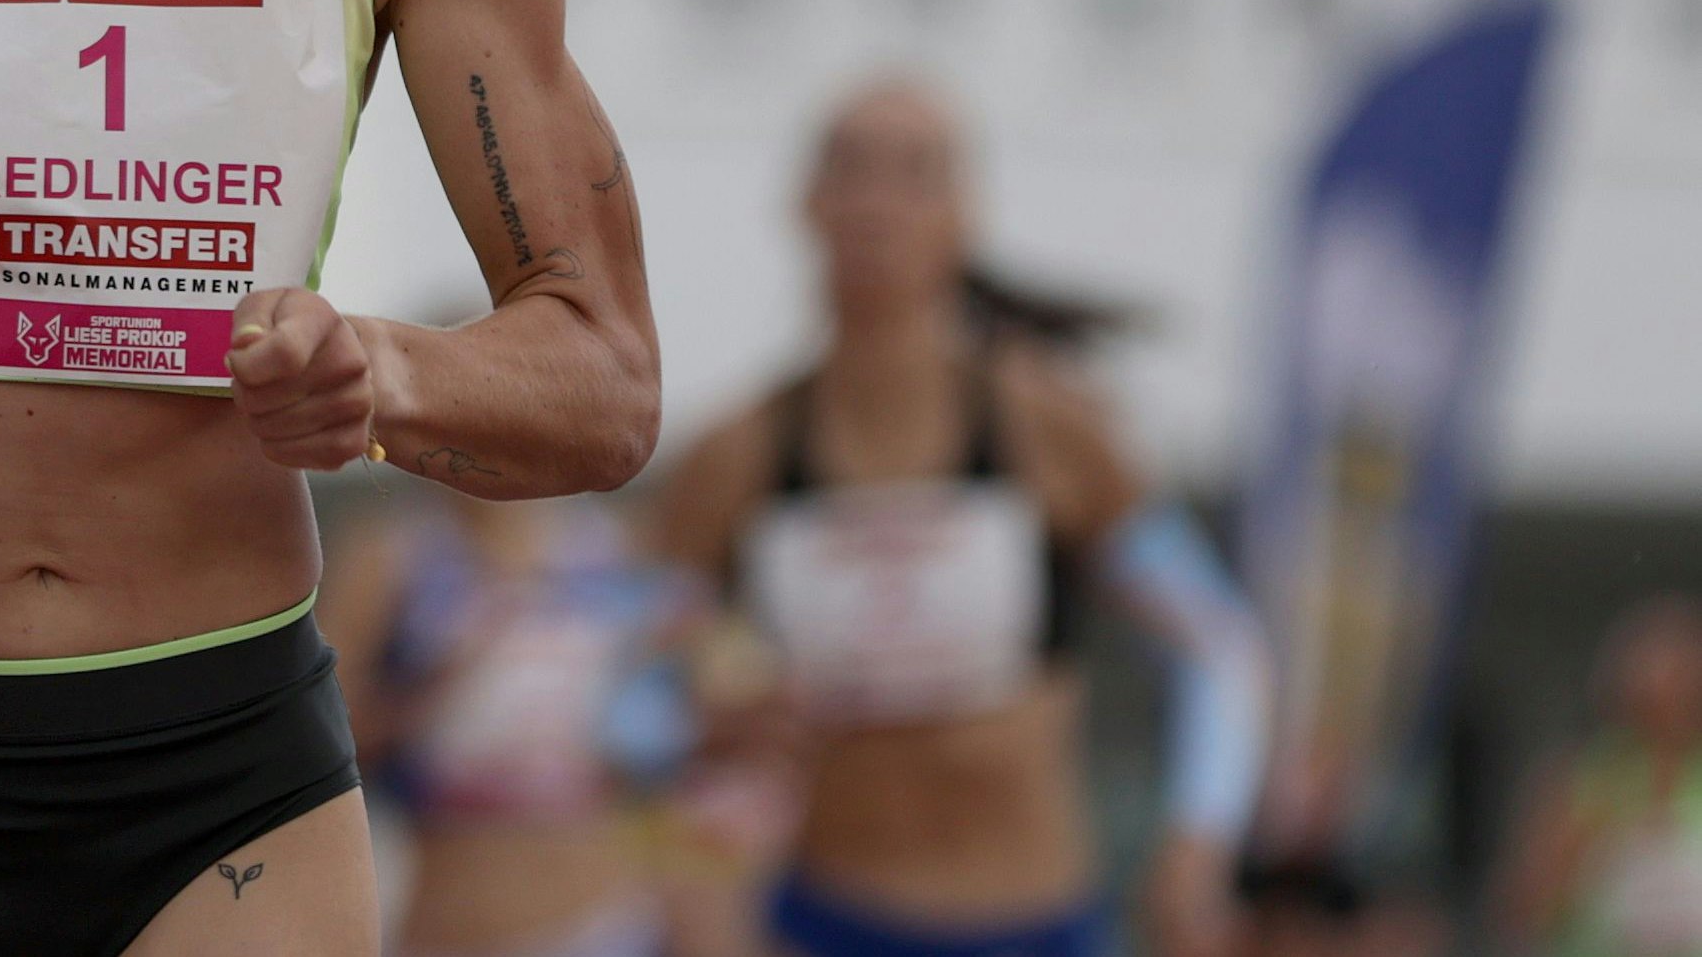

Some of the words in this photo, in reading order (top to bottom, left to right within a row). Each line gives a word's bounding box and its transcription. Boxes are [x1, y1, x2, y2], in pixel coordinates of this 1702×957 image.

[79, 25, 126, 131] 1
[3, 221, 248, 263] TRANSFER
[90, 315, 162, 329] SPORTUNION
[63, 326, 113, 345] LIESE
[116, 329, 187, 348] PROKOP
[64, 345, 184, 372] MEMORIAL
